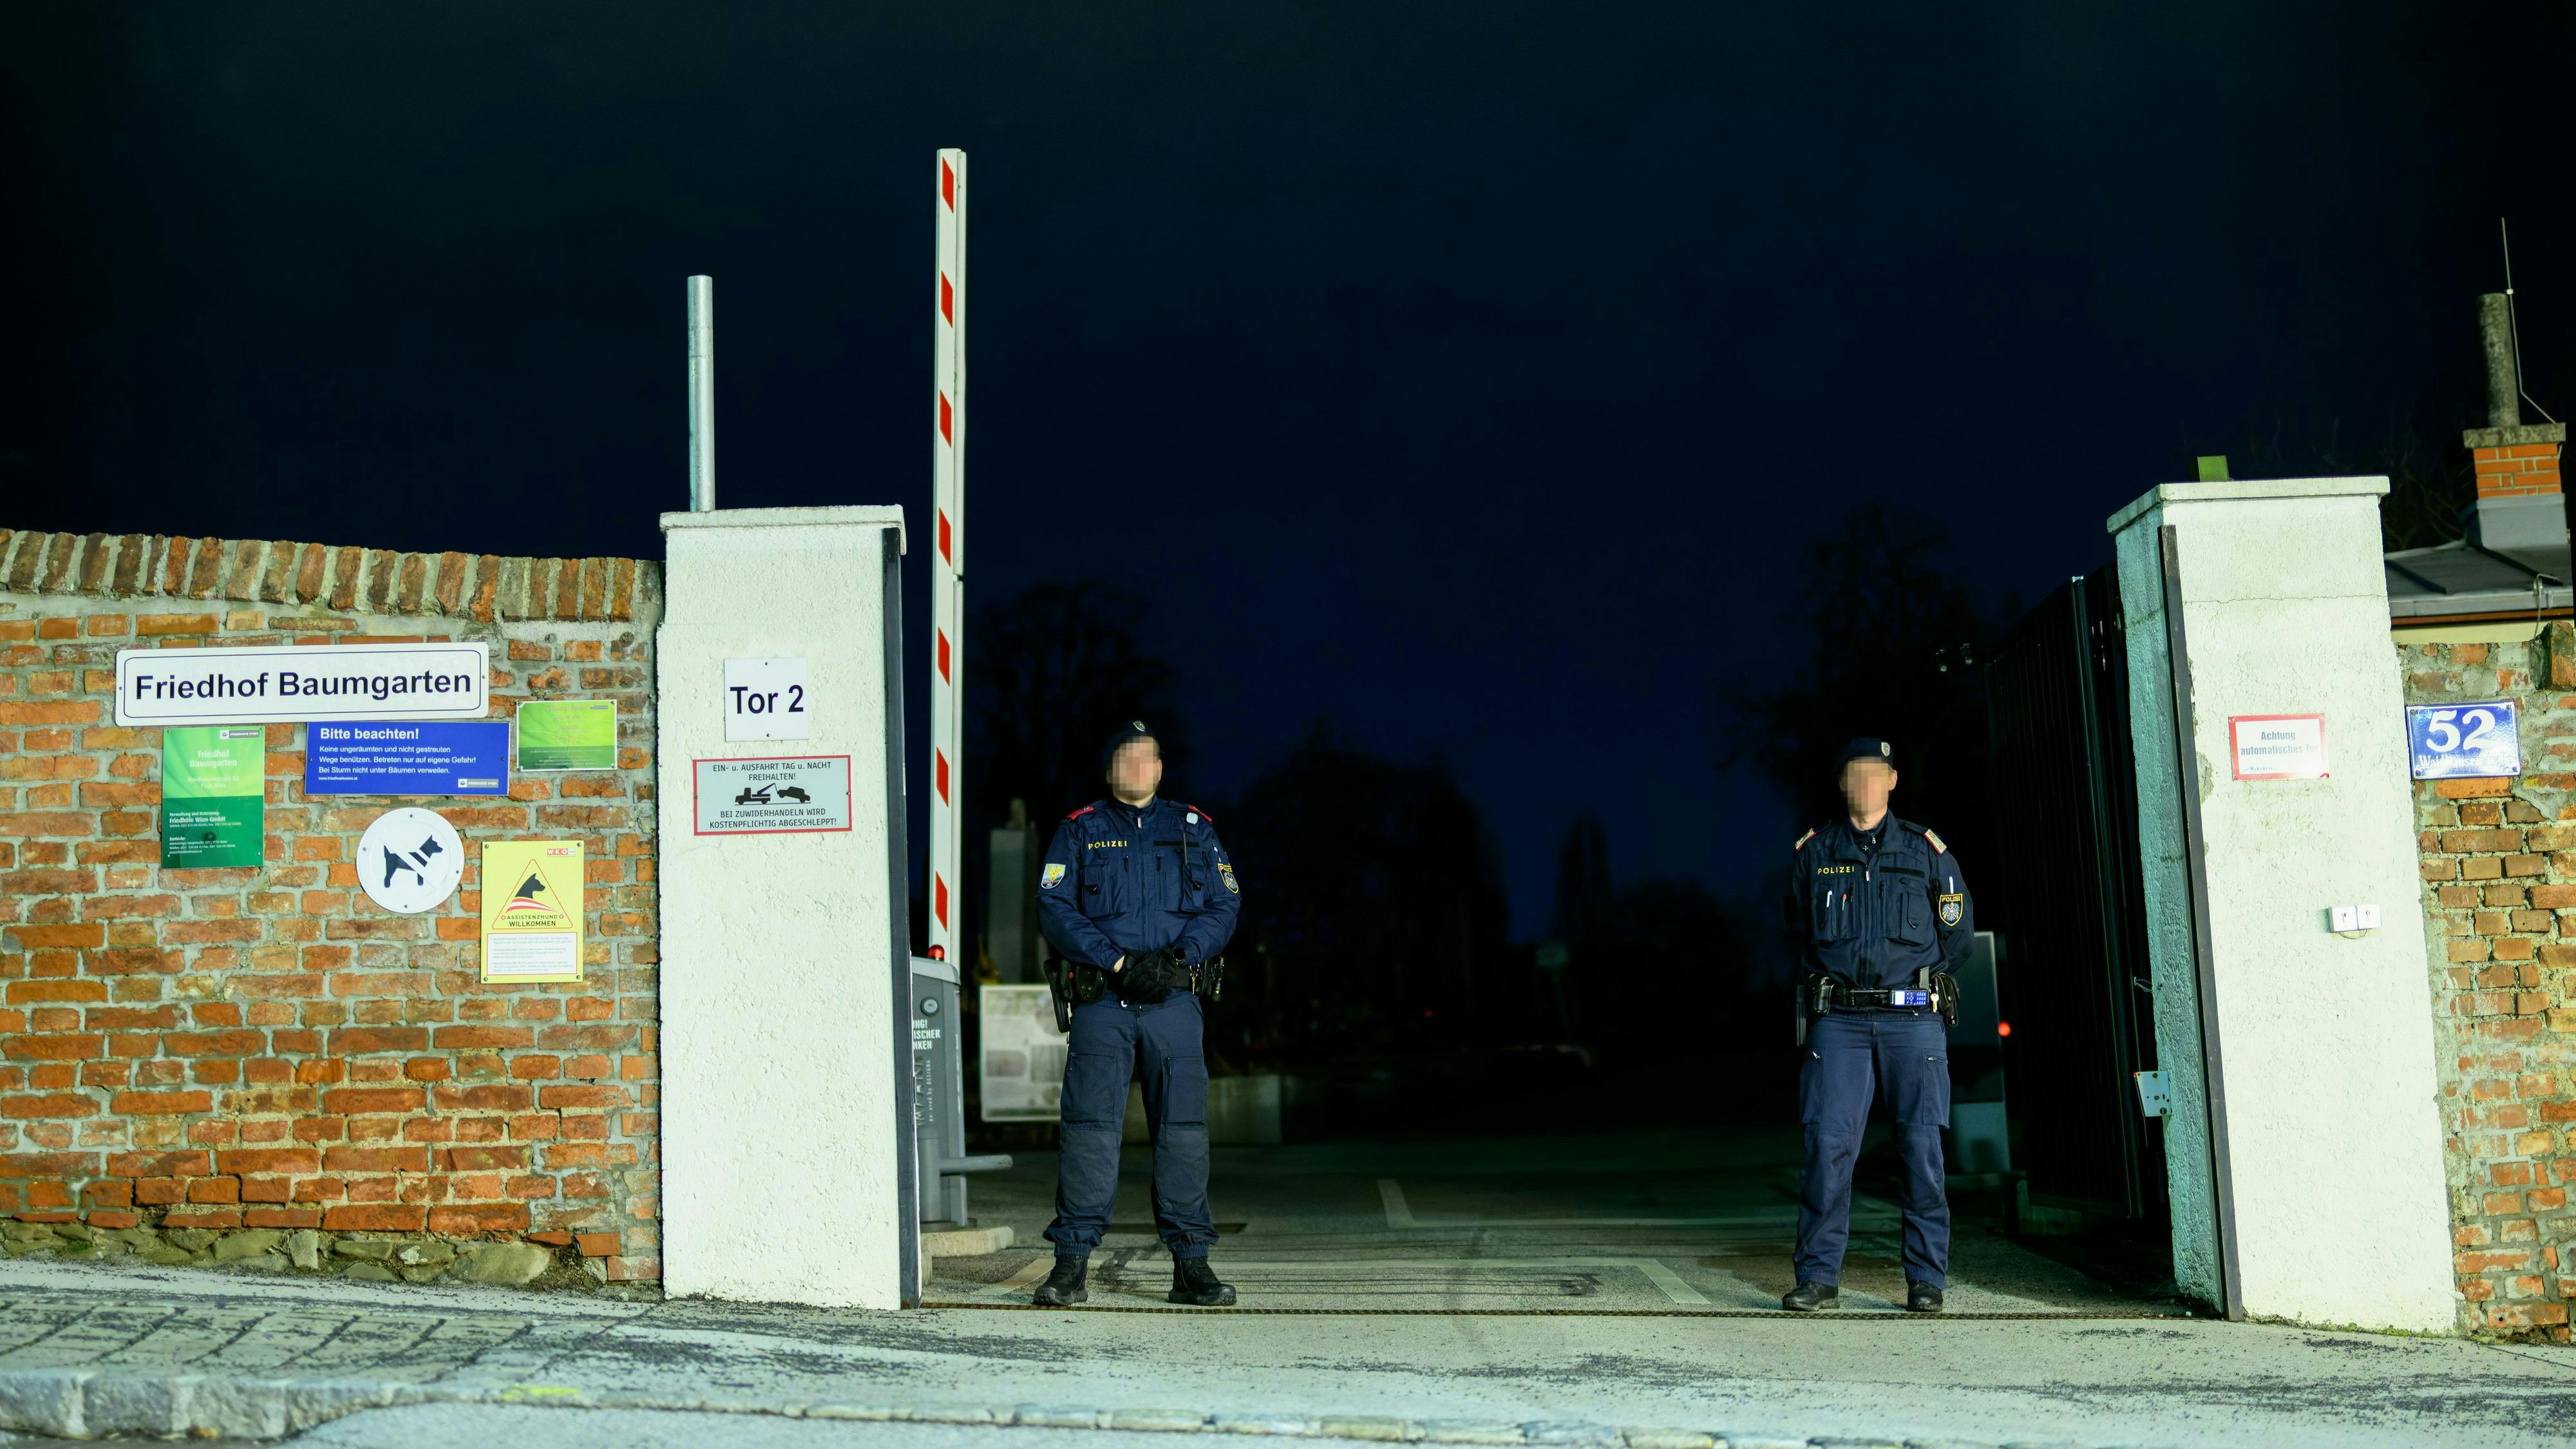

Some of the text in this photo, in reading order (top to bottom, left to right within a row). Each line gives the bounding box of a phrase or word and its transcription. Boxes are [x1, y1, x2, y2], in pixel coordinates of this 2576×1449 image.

[135, 669, 471, 701] Friedhof Baumgarten
[730, 685, 804, 714] Tor 2
[320, 727, 419, 739] Bitte beachten!
[2427, 709, 2499, 752] 52
[2261, 732, 2296, 741] Achtung
[198, 750, 229, 758] Friedhof
[2240, 745, 2303, 755] automatisches
[189, 759, 237, 768] Baumgarten
[319, 756, 339, 764] Wege
[735, 810, 804, 818] ZUWIDERHANDELN
[710, 818, 837, 829] KOSTENPFLICHTIG ABGESCHLEPPT!
[1088, 840, 1128, 850] POLIZEI
[1817, 866, 1855, 876] POLIZEI
